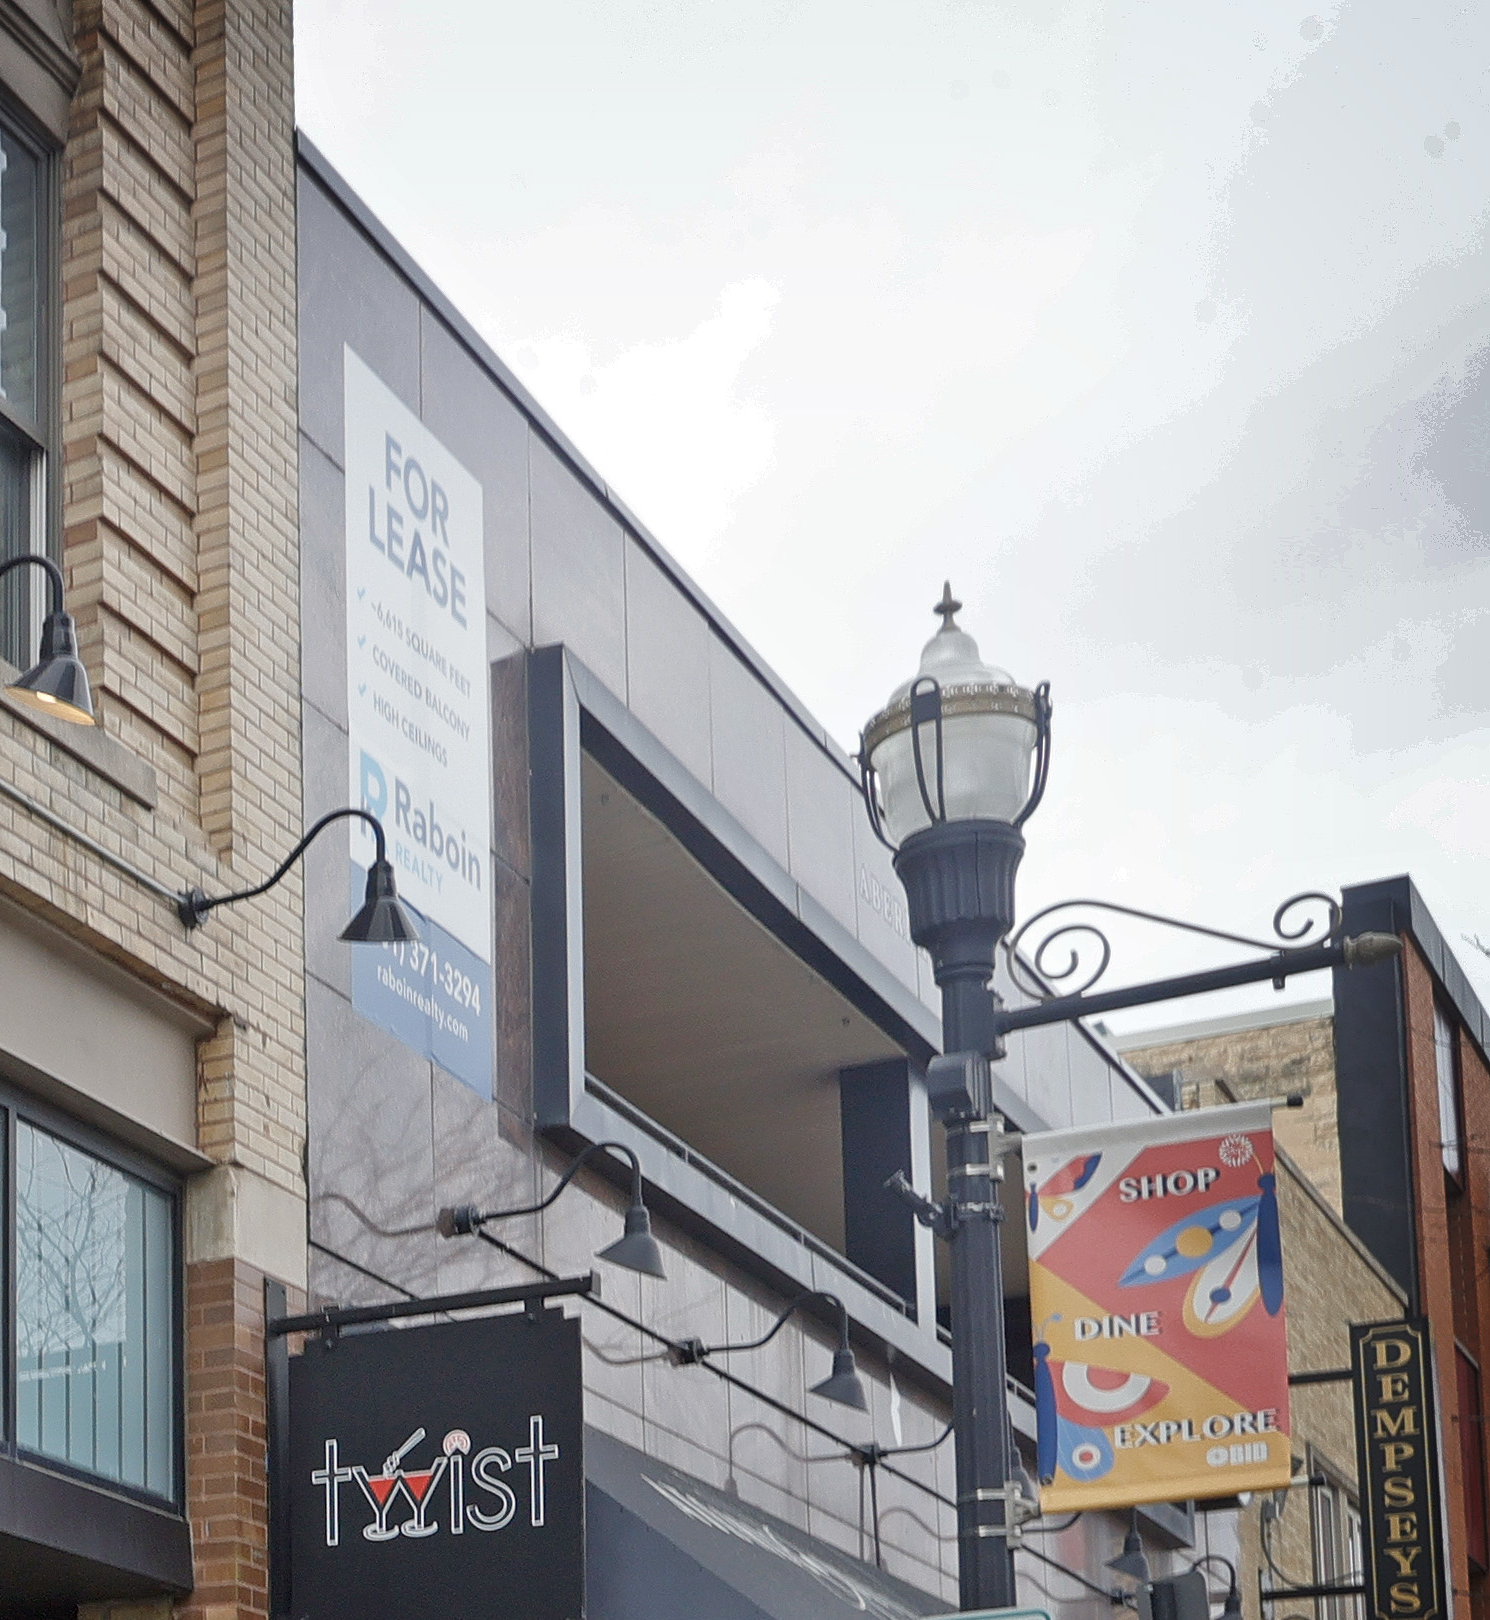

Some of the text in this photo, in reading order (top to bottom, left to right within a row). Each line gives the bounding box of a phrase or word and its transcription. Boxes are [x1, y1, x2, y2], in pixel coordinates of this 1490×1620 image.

[385, 430, 450, 549] FOR
[369, 484, 467, 631] LEASE
[372, 644, 470, 742] COVERED BALCONY
[406, 628, 447, 678] SQUARE
[449, 664, 471, 699] FEET
[373, 690, 448, 768] HIGH CEILINGS
[395, 776, 481, 892] Raboin
[396, 841, 444, 895] REALTY
[377, 965, 469, 1042] raboinrealty.com
[409, 940, 481, 1017] 371-3294
[1119, 1167, 1220, 1203] SHOP
[1074, 1311, 1162, 1341] DINE
[1113, 1408, 1279, 1449] EXPLORE
[311, 1415, 559, 1546] twist
[1371, 1338, 1421, 1614] DEMPSEYS
